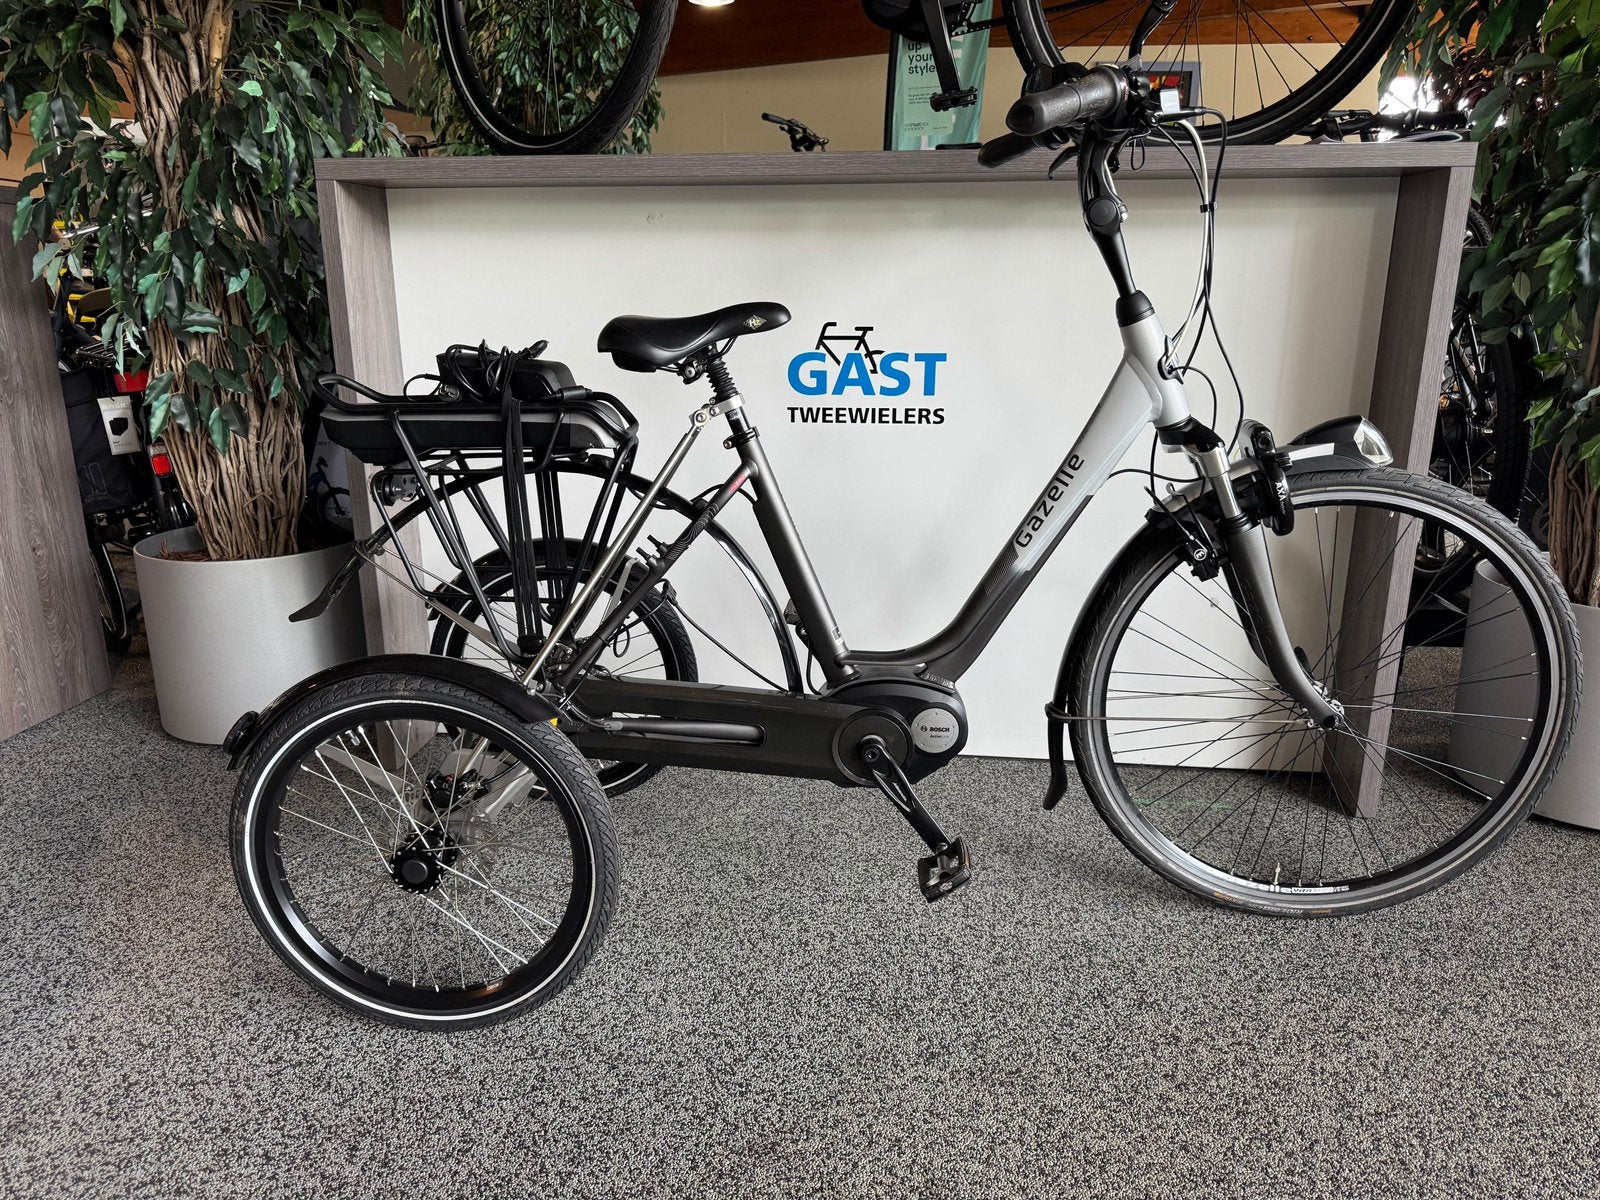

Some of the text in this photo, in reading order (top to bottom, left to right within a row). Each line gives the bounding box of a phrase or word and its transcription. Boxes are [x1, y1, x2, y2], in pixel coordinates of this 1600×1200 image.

[908, 42, 922, 53] up
[908, 53, 933, 64] your
[908, 63, 936, 76] style
[788, 352, 947, 396] GAST
[787, 407, 945, 424] TWEEWIELERS
[1275, 482, 1286, 502] AXA
[1015, 454, 1085, 548] Gazelle
